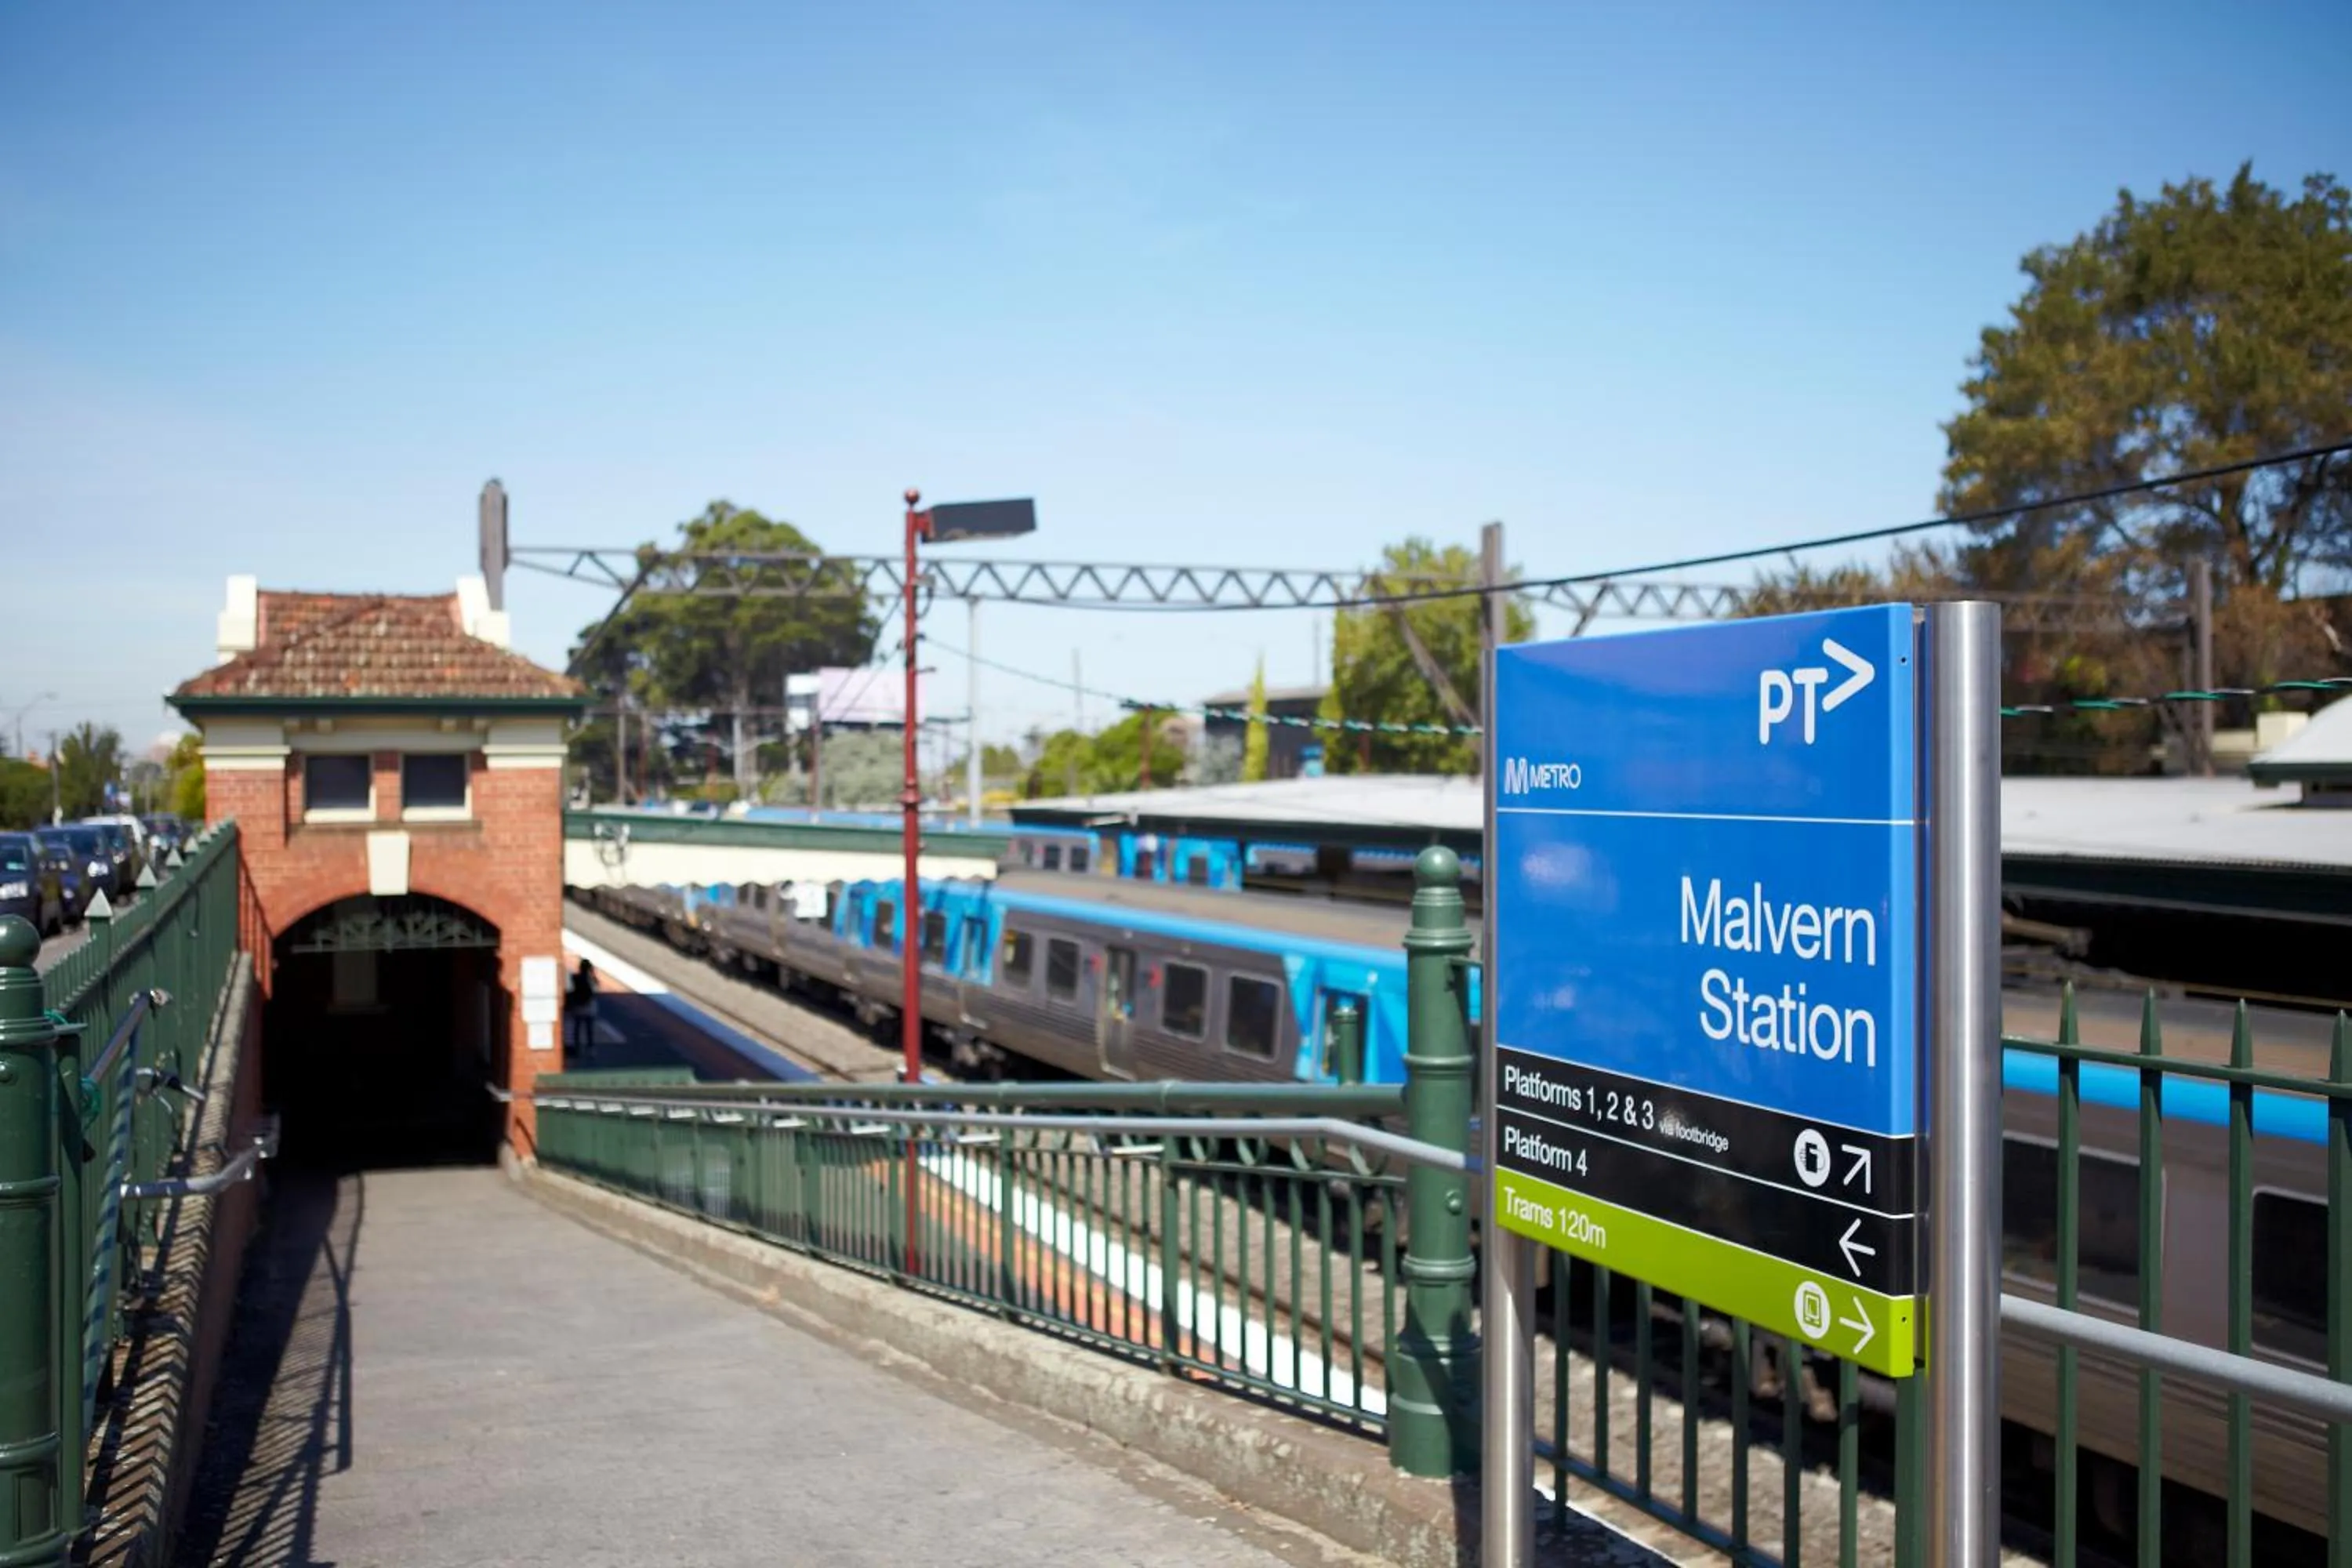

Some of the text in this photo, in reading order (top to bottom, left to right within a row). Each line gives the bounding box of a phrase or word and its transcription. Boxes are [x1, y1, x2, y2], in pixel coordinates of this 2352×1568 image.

[1530, 764, 1581, 789] METRO
[1682, 876, 1875, 966] Malvern
[1700, 968, 1875, 1067] Station
[1504, 1065, 1582, 1111] Platforms
[1607, 1091, 1618, 1120] 2
[1624, 1095, 1637, 1127] &
[1642, 1100, 1654, 1130] 3
[1659, 1120, 1675, 1135] via
[1675, 1123, 1729, 1152] footbridge
[1504, 1125, 1588, 1176] Platform 4
[1504, 1186, 1606, 1249] Trams 120m
